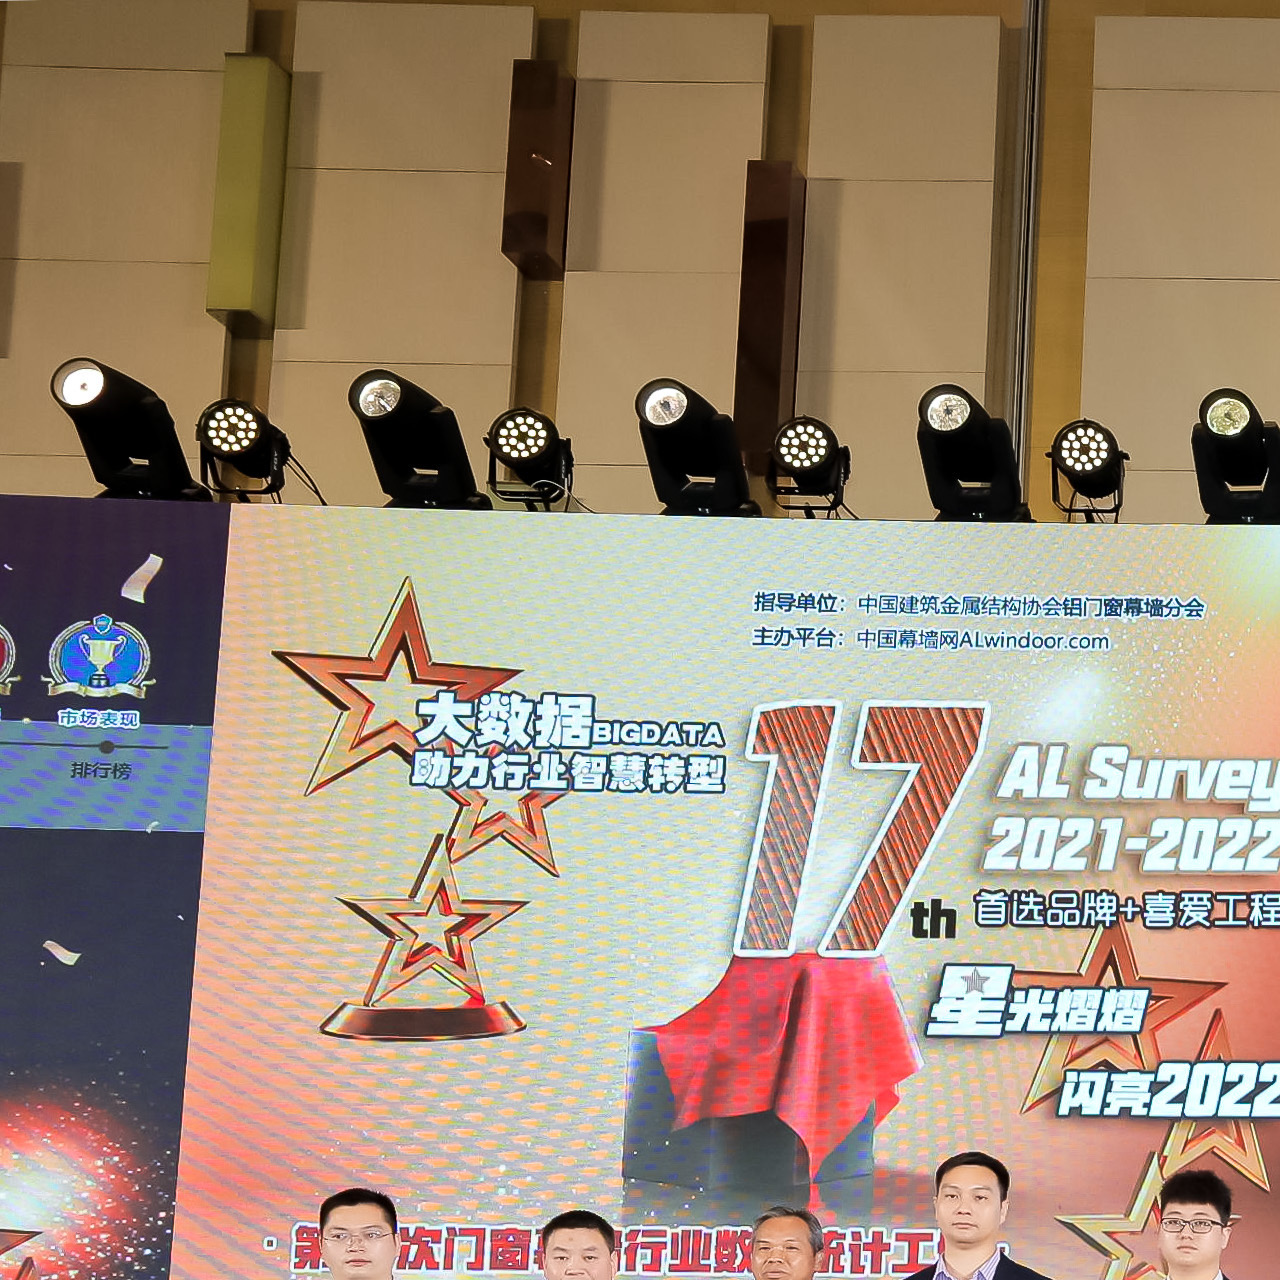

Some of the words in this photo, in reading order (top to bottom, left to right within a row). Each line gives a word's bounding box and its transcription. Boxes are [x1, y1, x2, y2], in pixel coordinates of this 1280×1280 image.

[58, 709, 140, 729] 市场表现
[71, 761, 132, 781] 排行榜
[410, 750, 726, 793] 助力行业智慧转型
[997, 744, 1070, 800] AL
[926, 963, 1151, 1038] 星光熠熠
